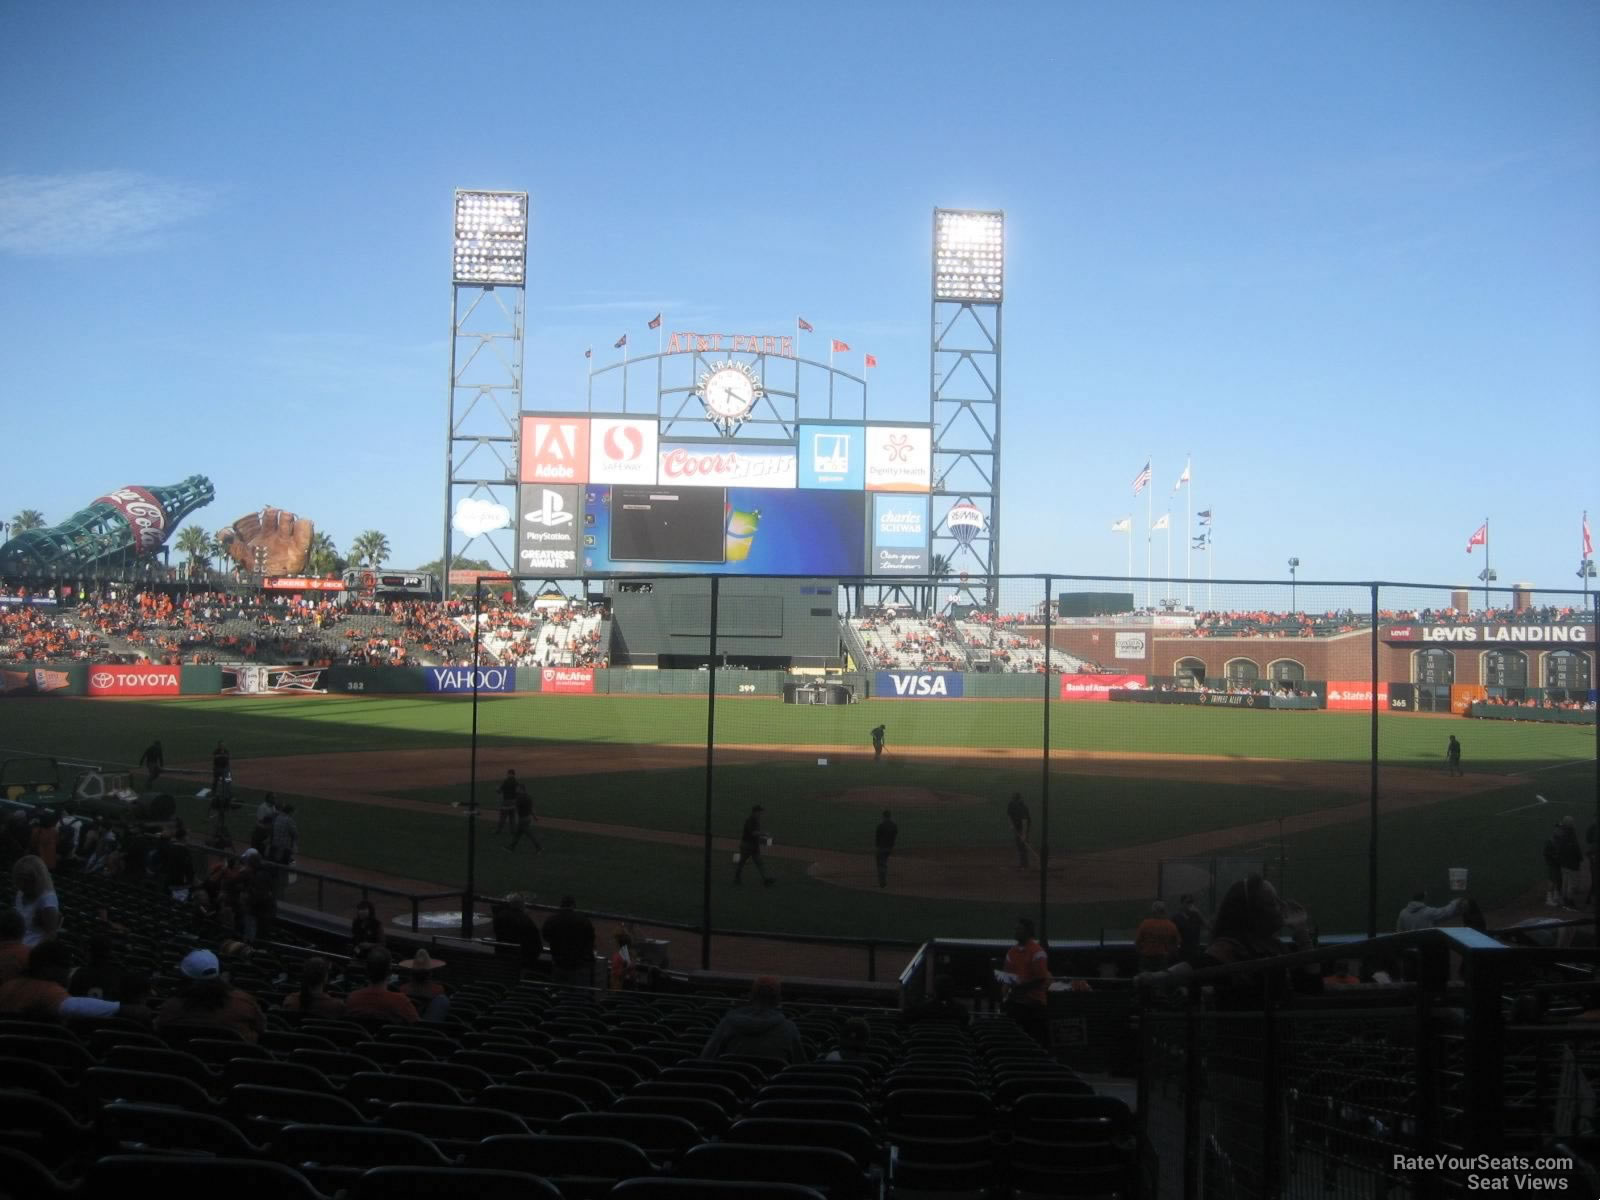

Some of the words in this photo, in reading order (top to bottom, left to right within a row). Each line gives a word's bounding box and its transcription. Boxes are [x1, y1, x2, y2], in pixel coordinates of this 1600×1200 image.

[667, 332, 723, 354] AT&T
[733, 335, 792, 358] PARK
[695, 371, 710, 397] SAN
[705, 410, 753, 426] GIANTS
[662, 447, 736, 478] Coors
[535, 463, 575, 478] Adobe
[869, 466, 898, 477] Dignity
[900, 466, 926, 476] Health
[521, 549, 576, 560] GREATNESS
[1484, 626, 1586, 642] LANDING
[117, 674, 178, 687] TOYOTA
[433, 668, 507, 691] YAHOO!
[556, 671, 592, 681] McAfee
[888, 674, 948, 696] VISA
[1066, 683, 1084, 691] Bank
[1343, 691, 1364, 700] State
[1391, 699, 1407, 707] 365
